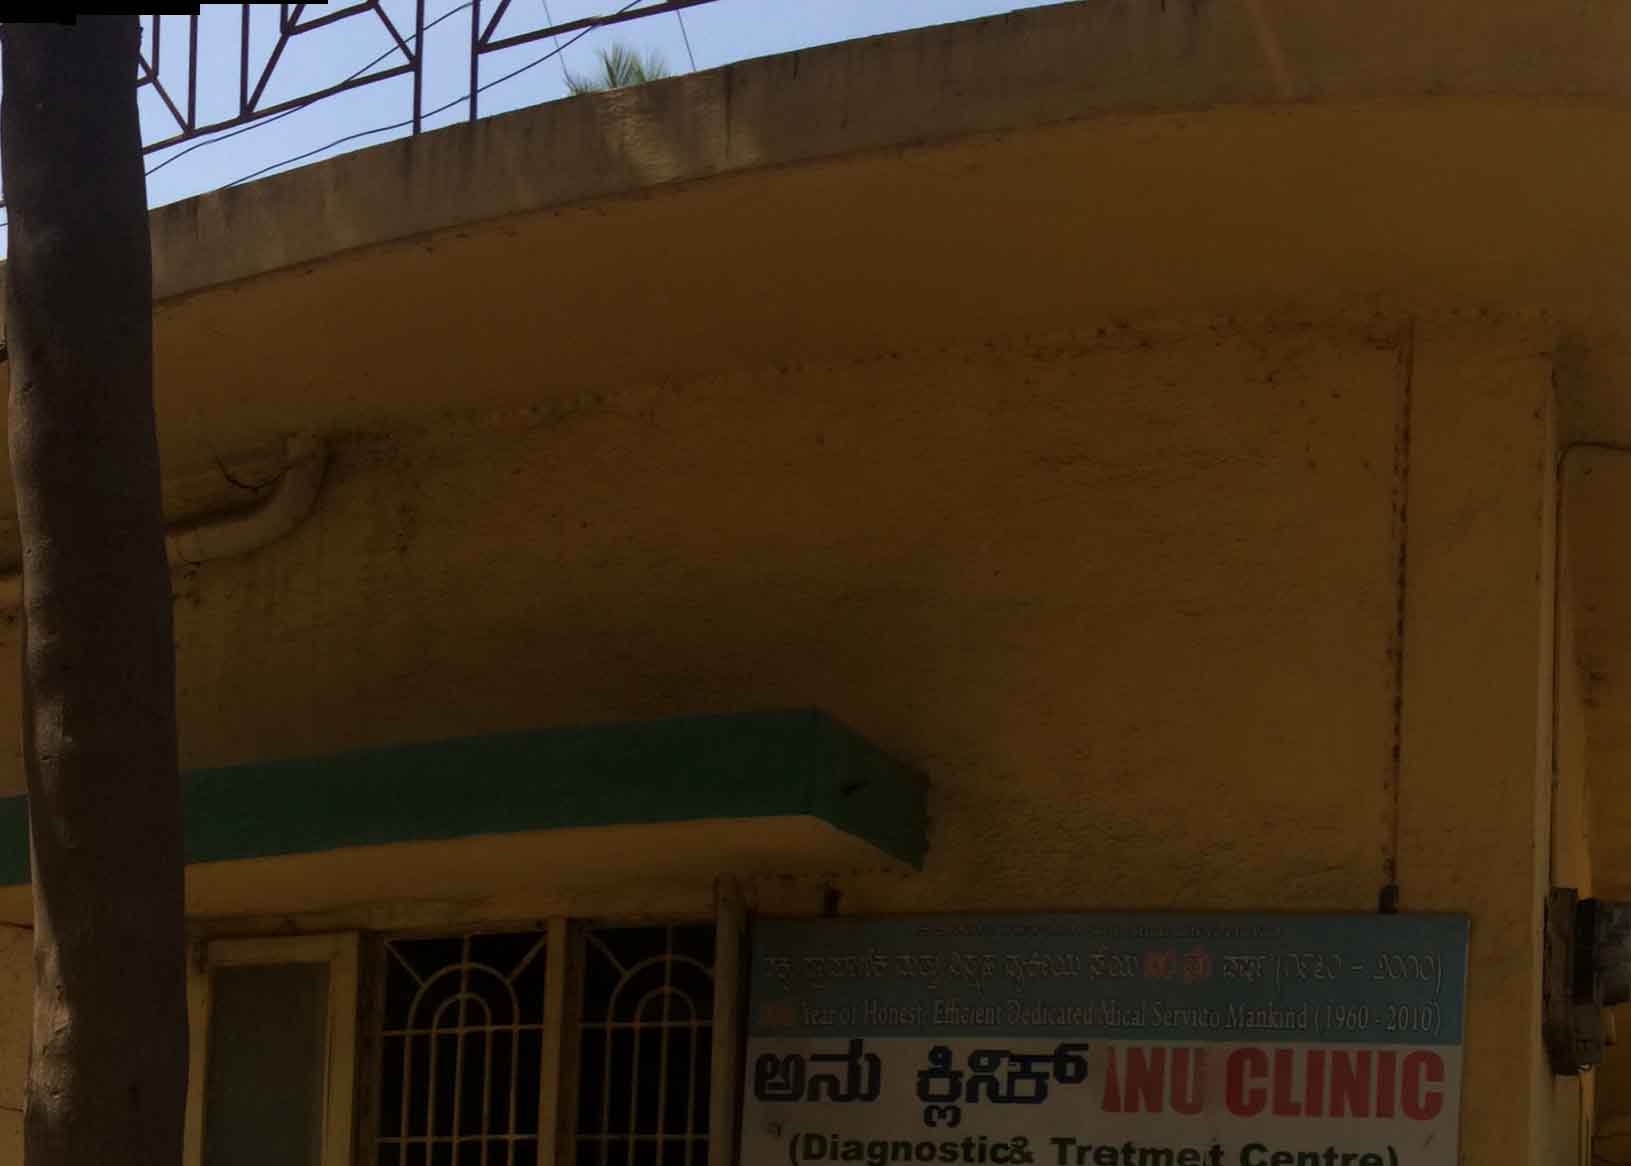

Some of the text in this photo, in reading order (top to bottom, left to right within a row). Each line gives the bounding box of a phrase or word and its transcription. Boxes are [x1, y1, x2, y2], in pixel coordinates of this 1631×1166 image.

[753, 1038, 1089, 1128] ಅನು ಕ್ಲಿನಿಕ್
[1224, 1046, 1445, 1121] CLINIC
